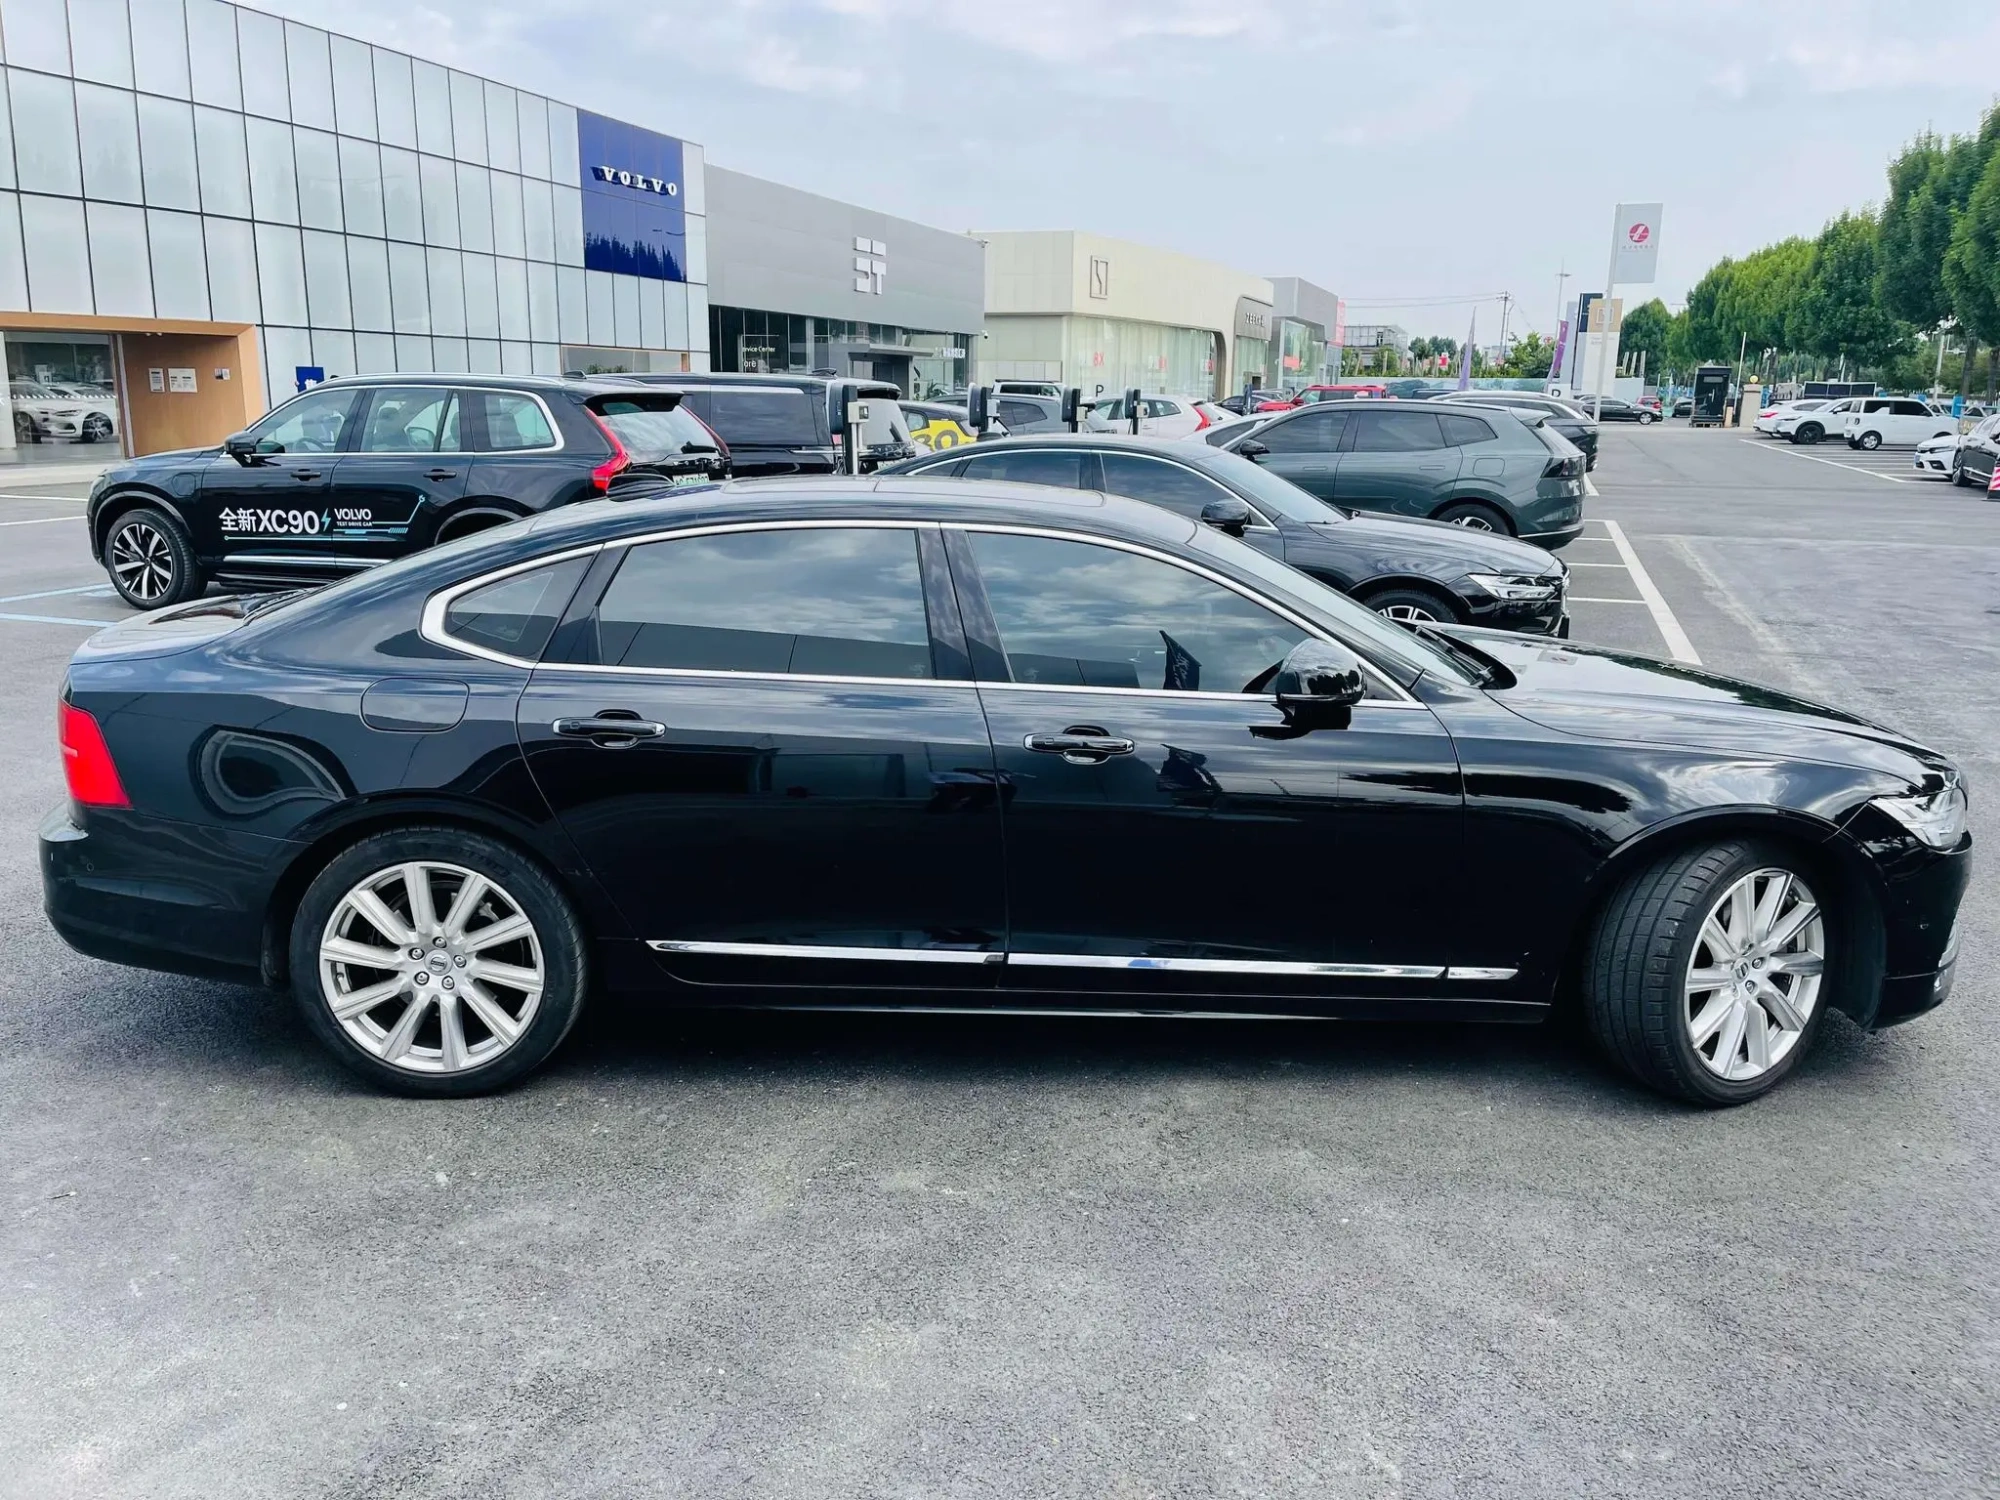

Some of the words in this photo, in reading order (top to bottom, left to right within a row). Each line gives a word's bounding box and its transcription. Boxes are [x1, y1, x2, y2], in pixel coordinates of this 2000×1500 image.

[601, 166, 678, 196] VOLVO
[758, 345, 776, 353] Center
[333, 508, 372, 520] VOLVO
